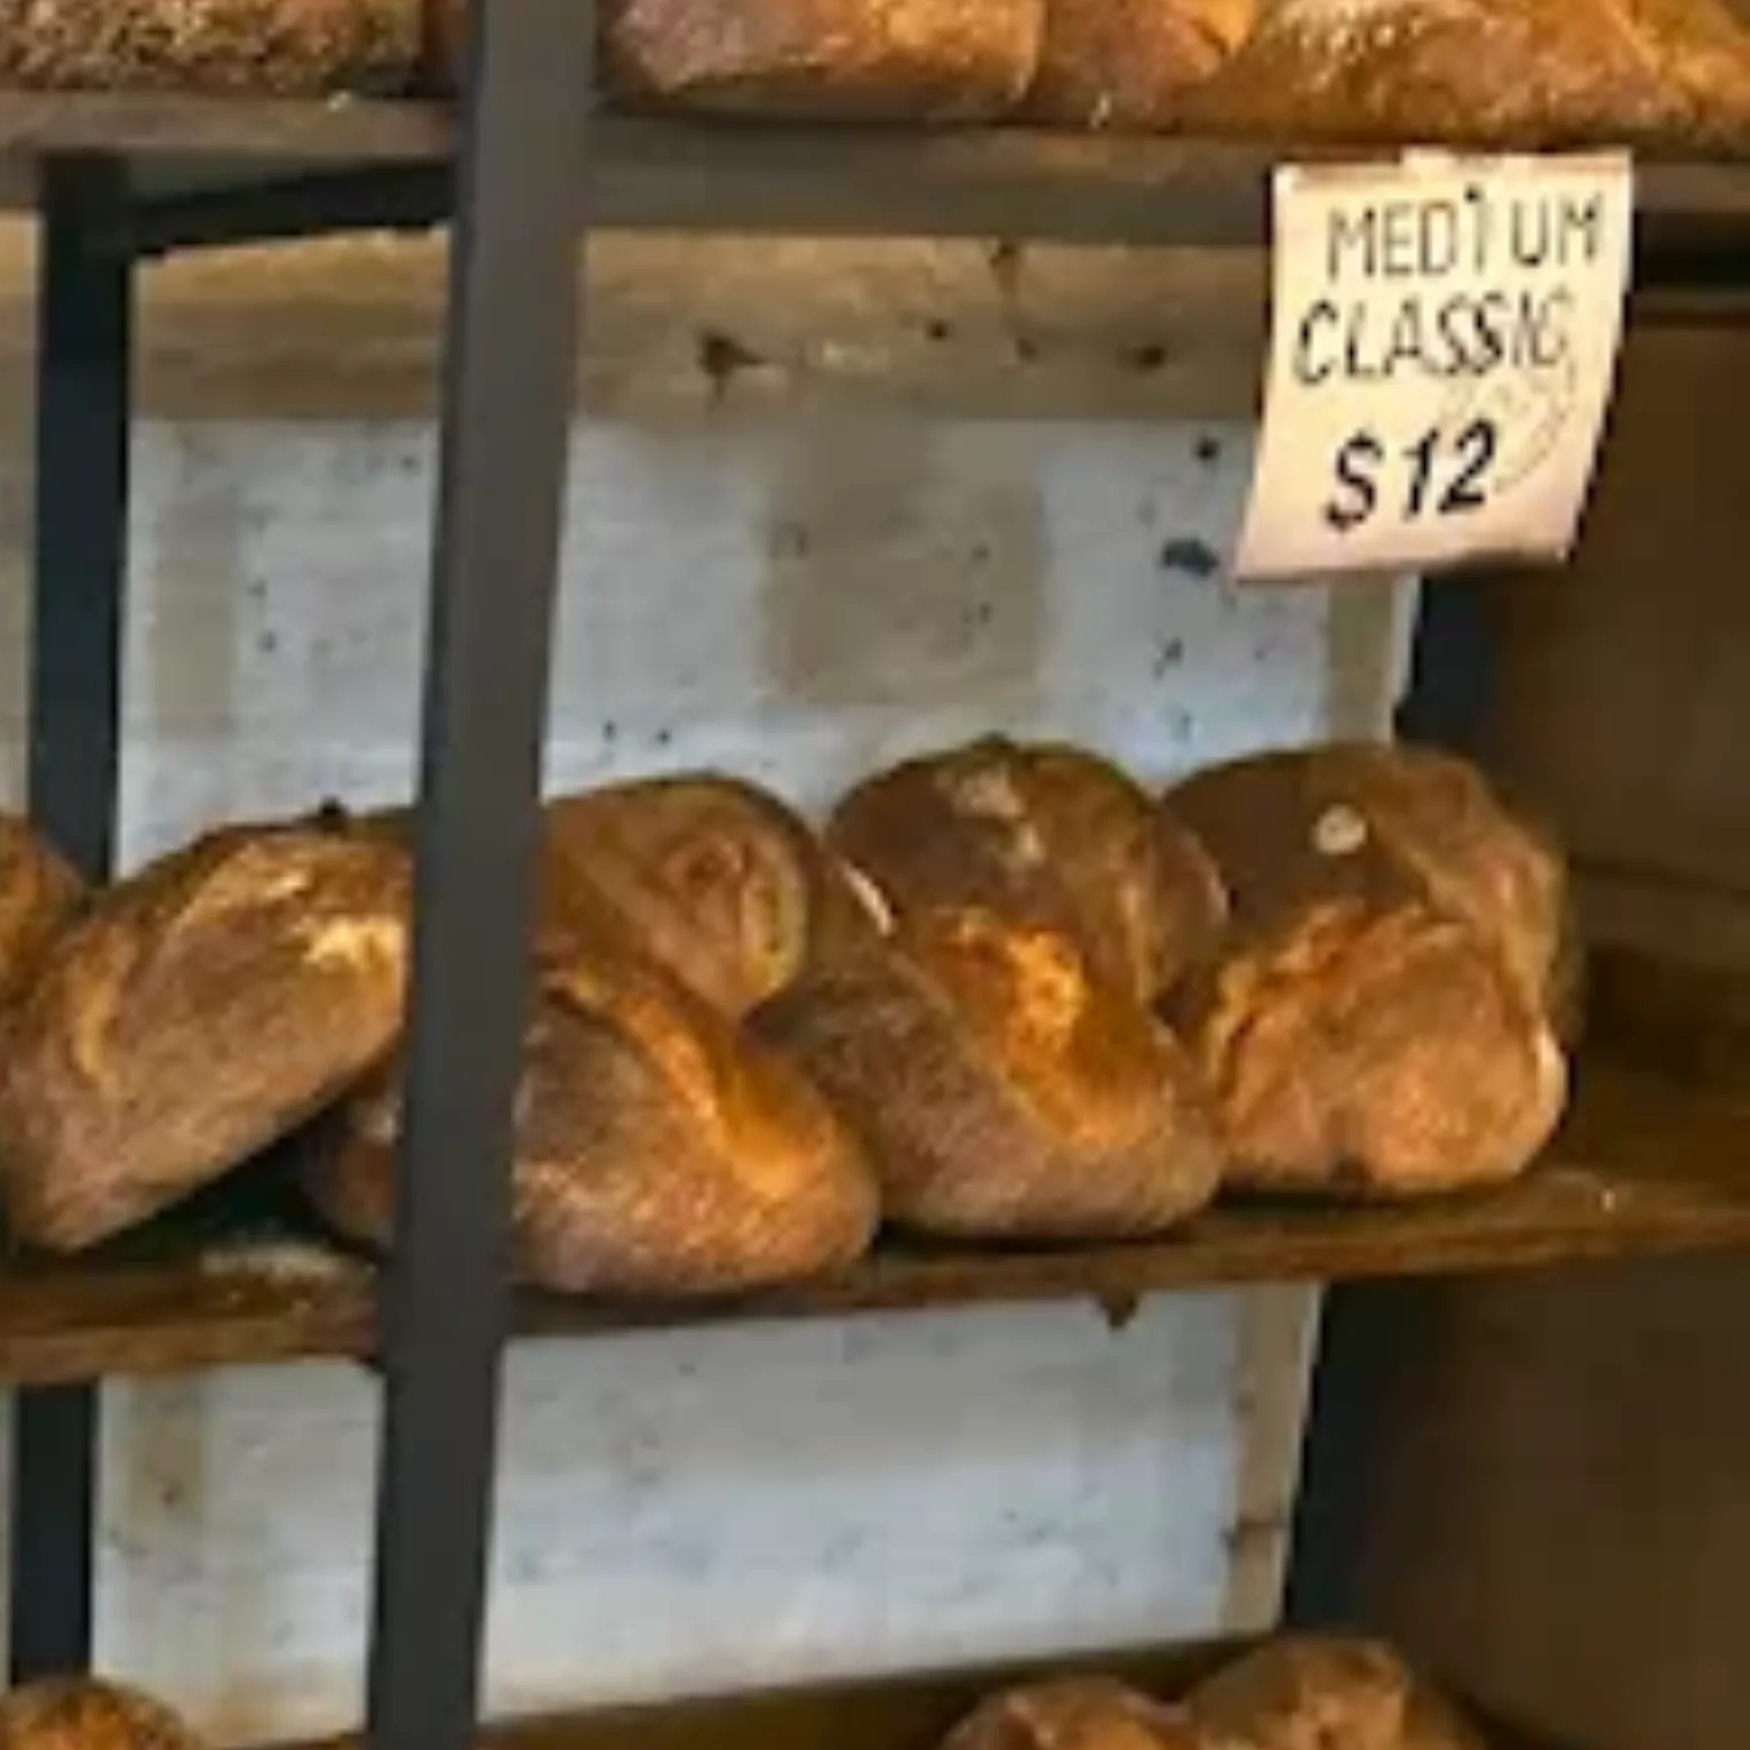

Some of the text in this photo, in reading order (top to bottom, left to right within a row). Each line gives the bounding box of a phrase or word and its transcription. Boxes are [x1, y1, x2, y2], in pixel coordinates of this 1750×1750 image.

[1327, 184, 1602, 281] MEDIUM
[1294, 286, 1575, 386] CLASSIC
[1324, 418, 1498, 531] $12
